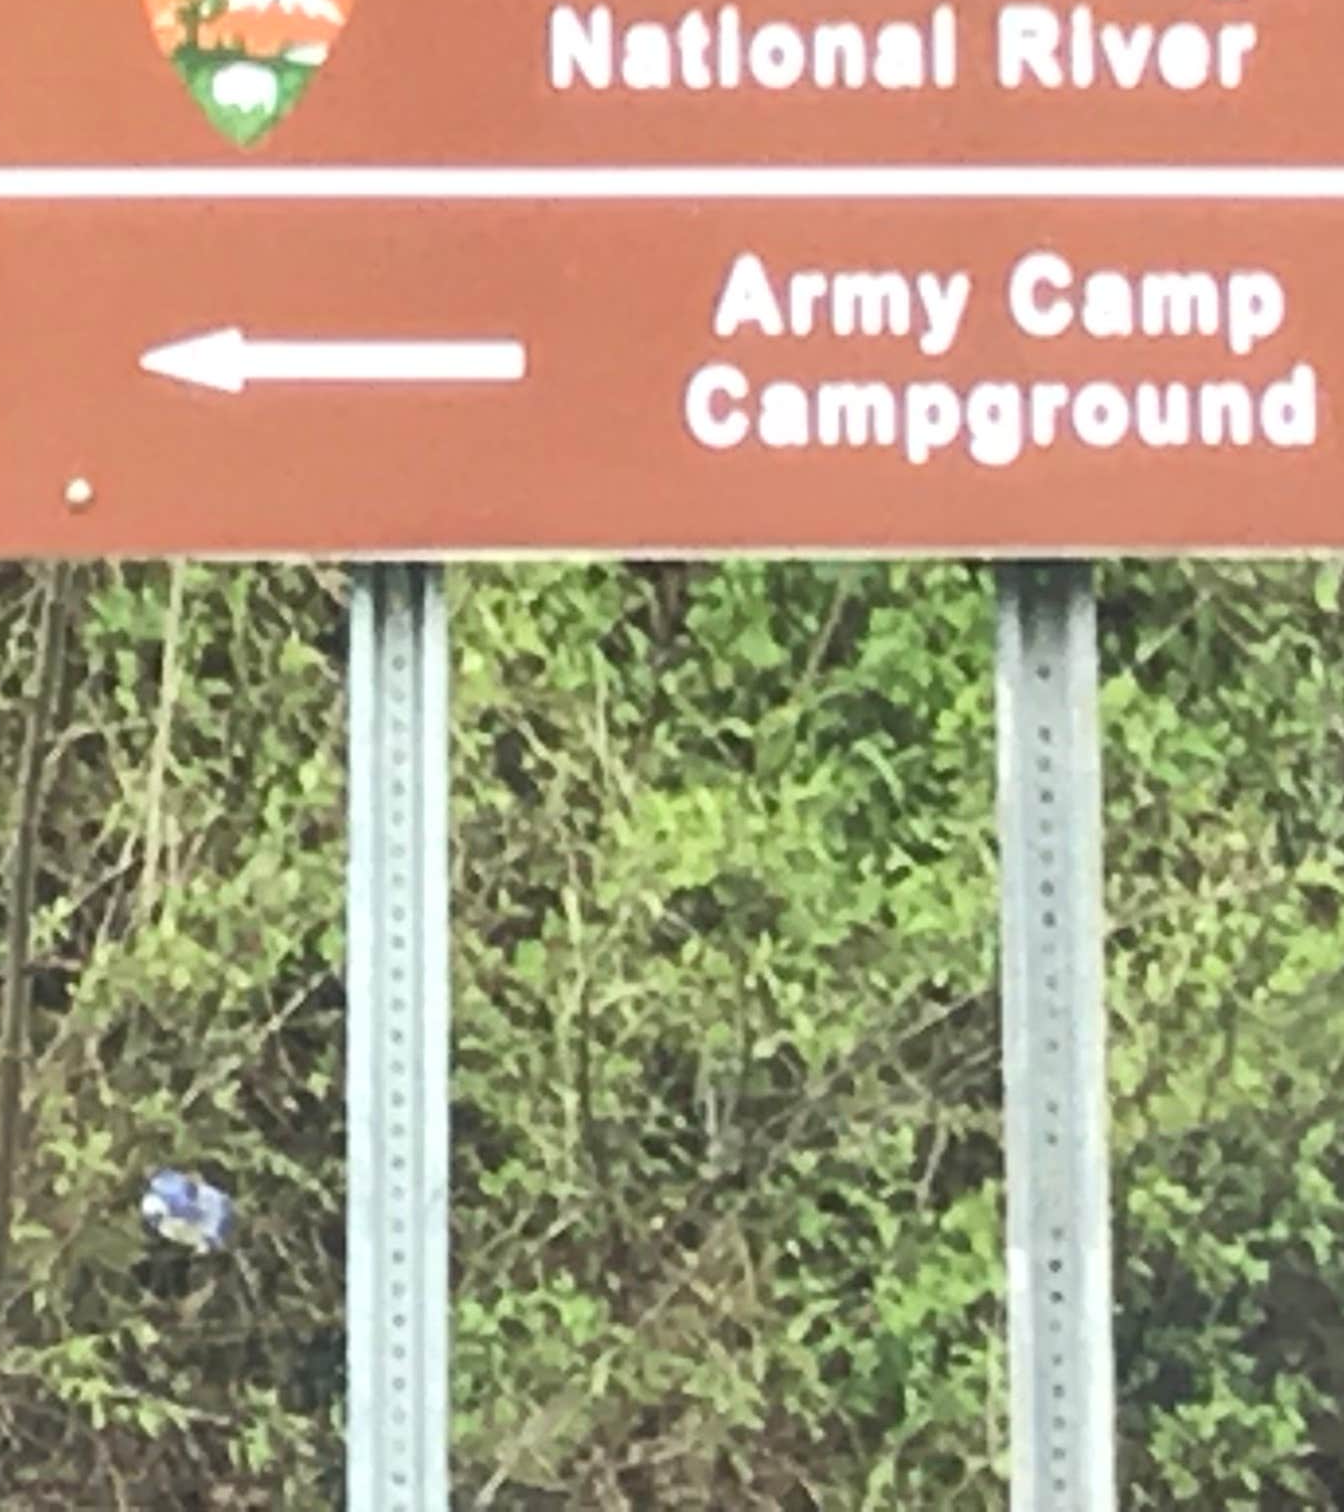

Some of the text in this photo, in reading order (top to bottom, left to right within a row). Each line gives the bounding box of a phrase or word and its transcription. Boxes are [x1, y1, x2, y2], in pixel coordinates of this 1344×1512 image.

[551, 4, 1258, 90] National River
[714, 251, 1285, 355] Army Camp
[684, 363, 1317, 466] Campground
